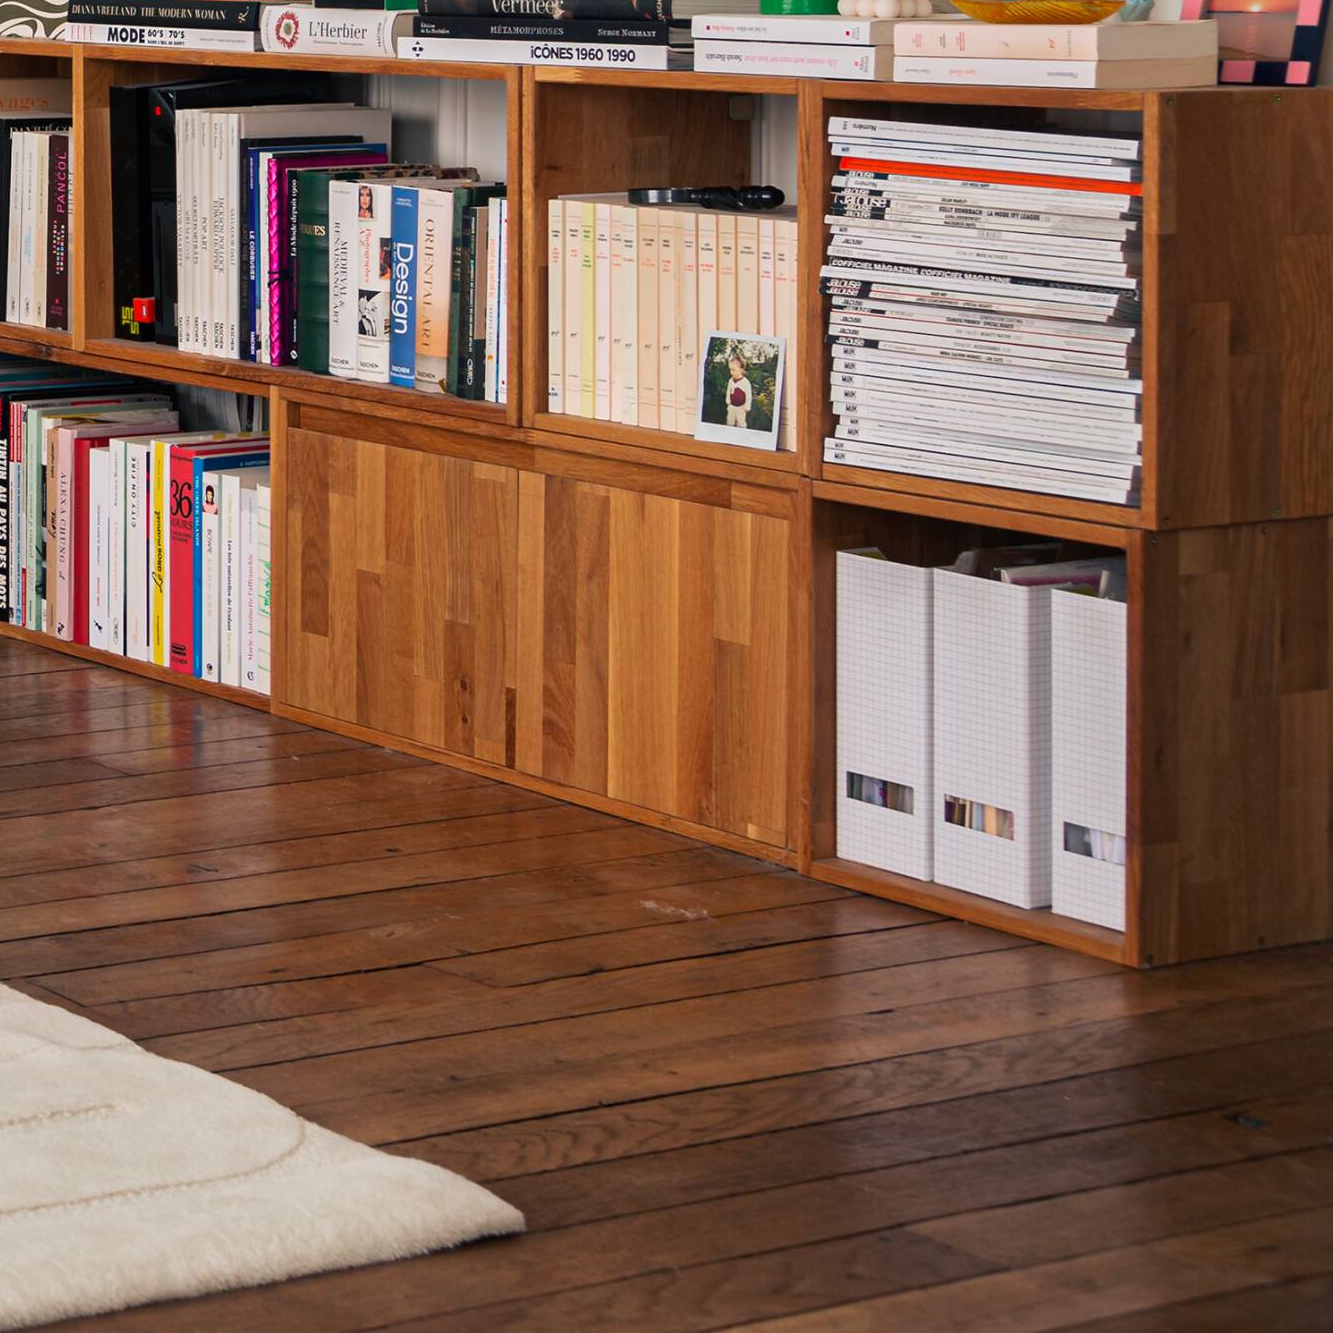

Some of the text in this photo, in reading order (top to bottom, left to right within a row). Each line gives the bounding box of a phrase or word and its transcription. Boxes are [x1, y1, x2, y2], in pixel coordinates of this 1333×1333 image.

[71, 4, 226, 20] DIANA VREELAND THE MODERN WOMAN
[70, 24, 94, 41] ELLE
[107, 27, 145, 44] MODE
[147, 29, 164, 38] 60'S
[168, 30, 185, 39] 70'S
[308, 21, 368, 40] L'Herbier
[490, 24, 564, 35] MÉTAMORPHOSES
[575, 47, 604, 61] 1960
[606, 48, 636, 62] 1990
[57, 151, 67, 213] PANCOL
[290, 198, 298, 223] depuis
[838, 195, 886, 209] Jalouse
[249, 230, 255, 239] LE
[290, 247, 297, 257] La
[333, 222, 341, 300] RENAISSANCE
[339, 240, 348, 297] MEDIEVAL
[872, 262, 920, 275] MAGAZINE
[391, 242, 414, 334] Design
[421, 218, 435, 349] ORIENTAL ART
[131, 483, 137, 499] ON
[170, 479, 192, 519] 36
[58, 472, 67, 563] ALEXA CHUNG
[154, 510, 162, 547] manuel
[151, 571, 164, 594] Le
